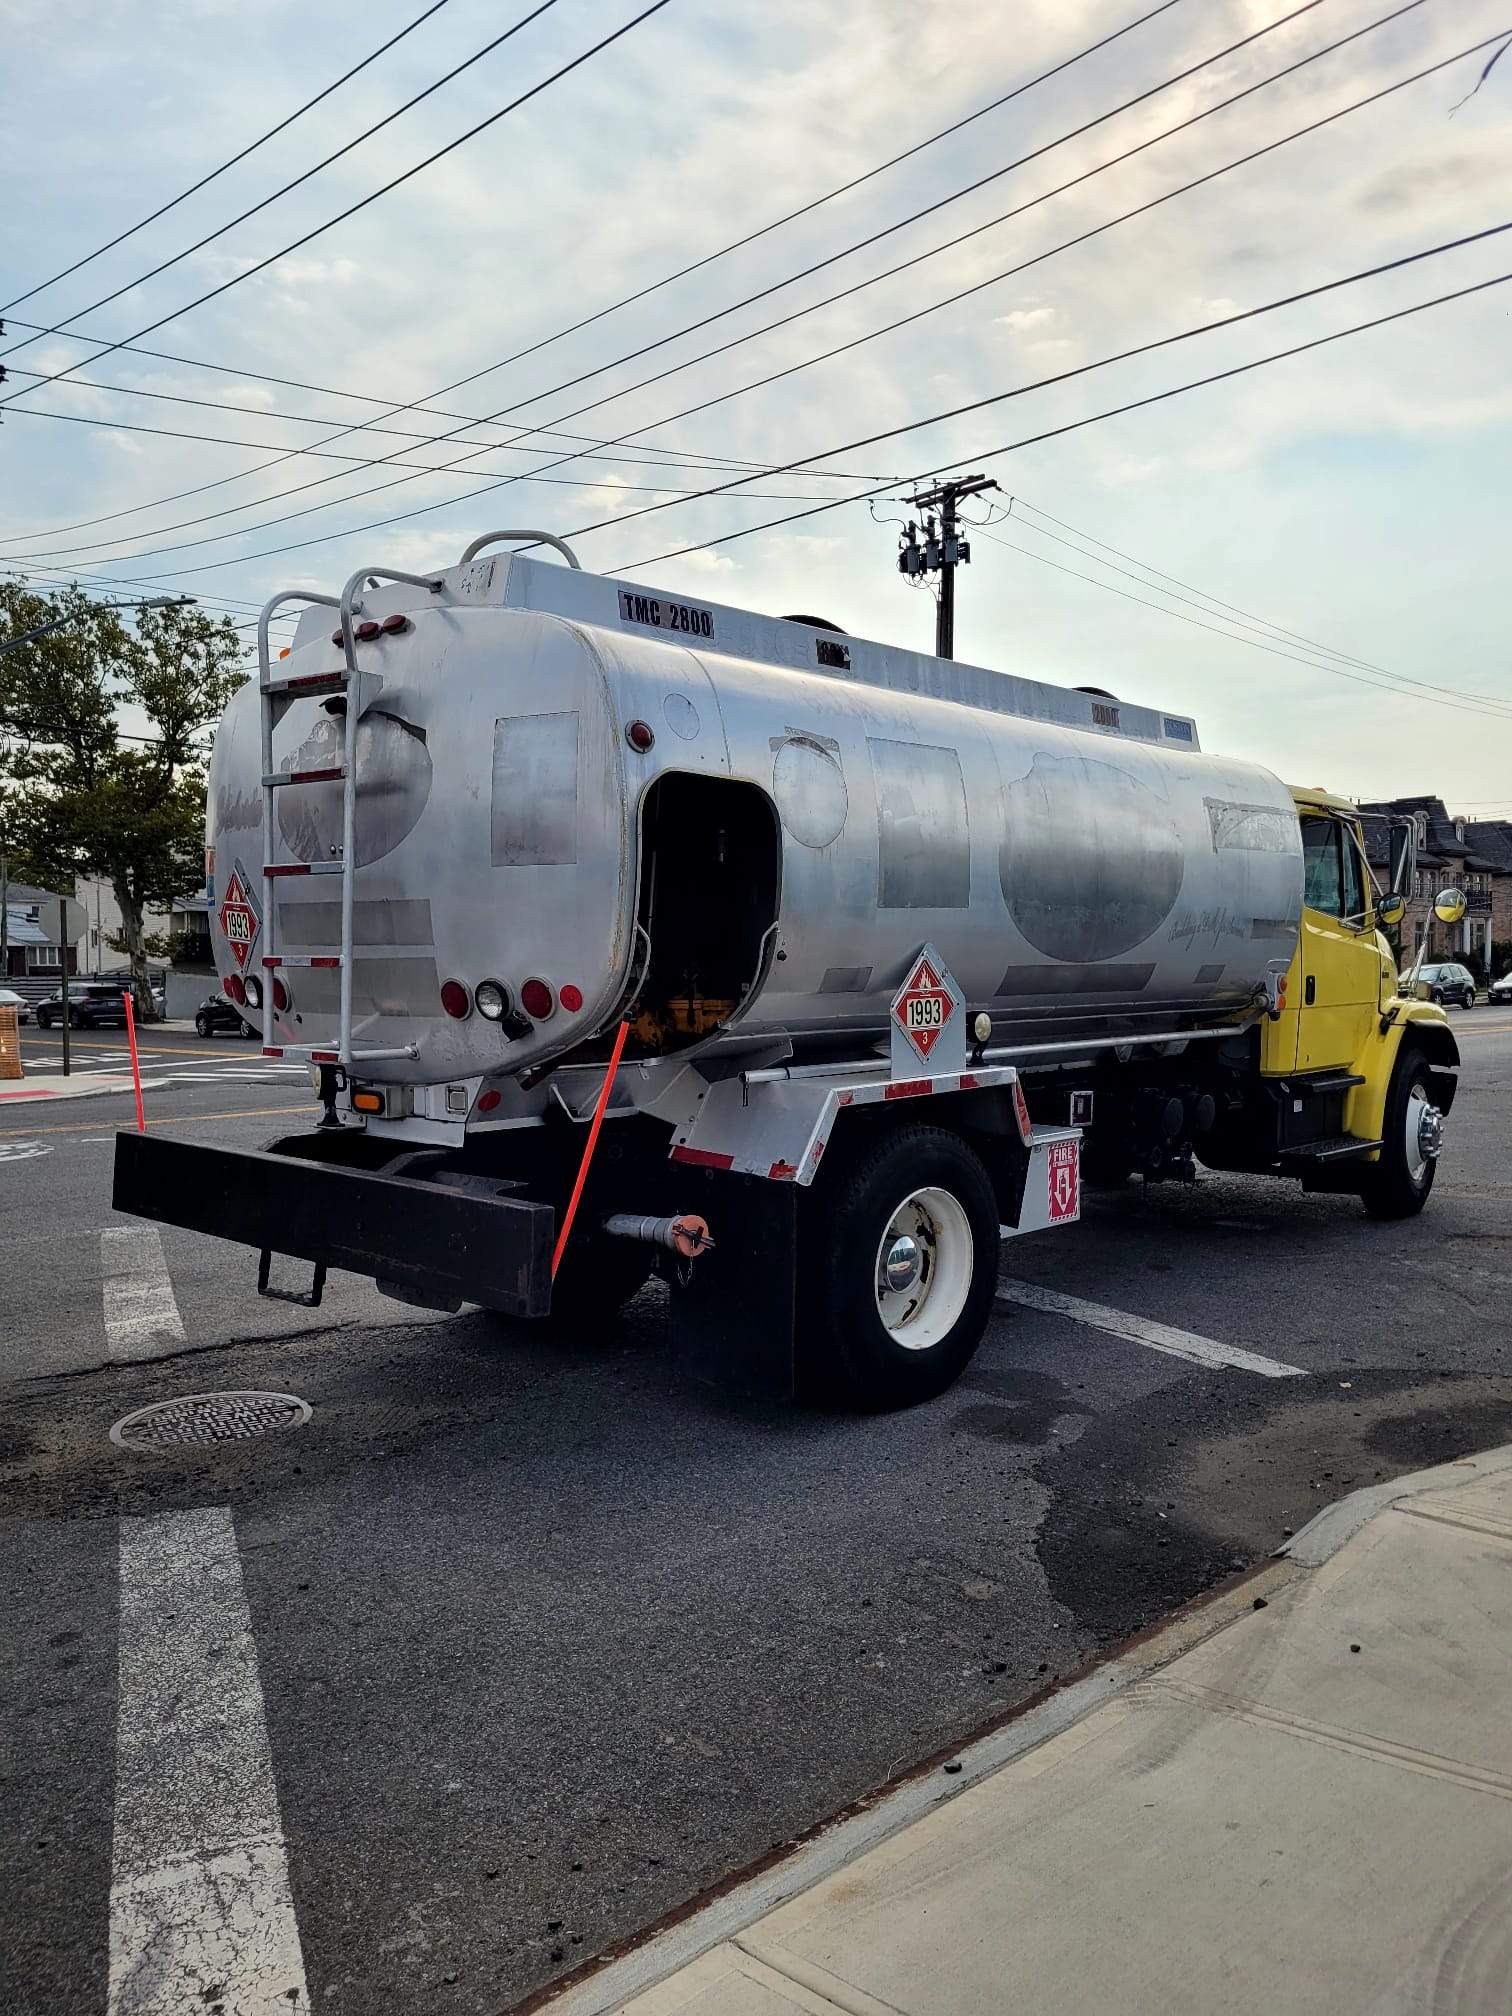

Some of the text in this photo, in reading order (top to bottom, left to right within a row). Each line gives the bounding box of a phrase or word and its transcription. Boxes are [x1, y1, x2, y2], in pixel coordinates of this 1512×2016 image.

[623, 593, 712, 637] TMC 2800
[227, 911, 249, 939] 1993
[908, 999, 941, 1026] 1993
[922, 1031, 928, 1044] 3
[1054, 1147, 1073, 1161] FIRE
